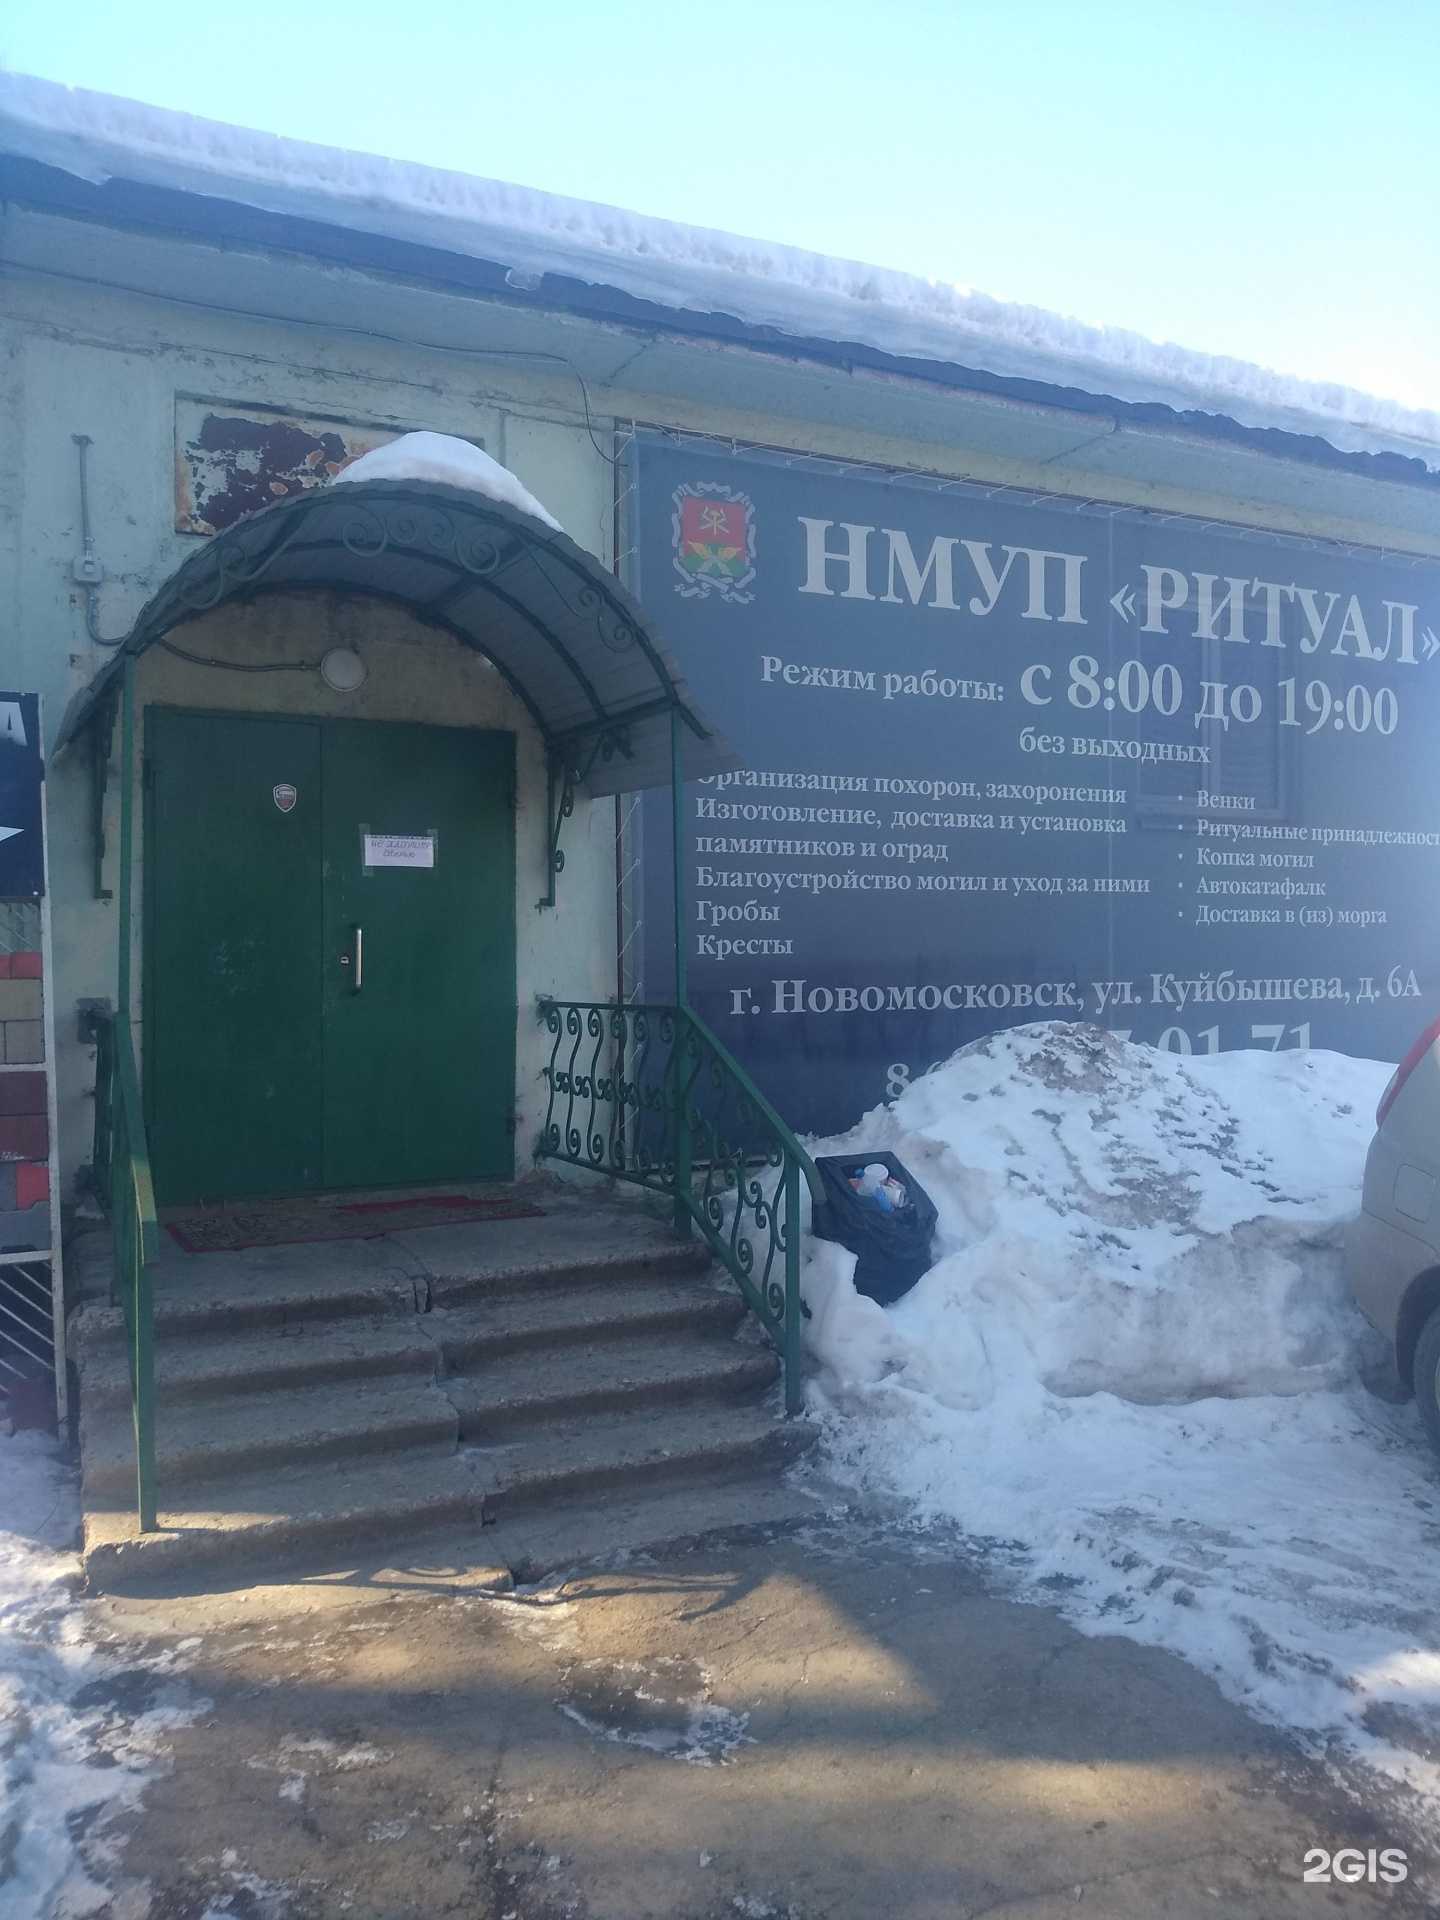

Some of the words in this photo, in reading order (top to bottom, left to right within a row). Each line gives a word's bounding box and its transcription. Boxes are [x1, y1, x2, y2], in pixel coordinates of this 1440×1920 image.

[798, 516, 1088, 625] НМУП
[760, 655, 877, 691] Режим
[883, 669, 1004, 702] работы:
[1067, 655, 1184, 716] 8:00
[1194, 681, 1263, 731] до
[1278, 677, 1399, 735] 19:00
[1019, 726, 1066, 754] без
[1071, 736, 1212, 765] выходных
[698, 770, 867, 793] рганизация
[874, 778, 982, 801] похорон,
[986, 783, 1127, 805] захоронения
[1196, 790, 1256, 810] Венки
[695, 797, 882, 829] Изготовление,
[890, 811, 995, 830] доставка
[1000, 814, 1015, 829] и
[1018, 815, 1128, 835] установка
[1196, 819, 1307, 842] Ритуальные
[695, 836, 855, 856] памятников
[860, 842, 877, 857] и
[882, 843, 949, 863] оград
[1196, 848, 1255, 866] Копка
[1260, 853, 1315, 868] могил
[695, 866, 912, 894] Благоустройство
[916, 876, 988, 891] могил
[993, 876, 1008, 891] и
[1011, 877, 1063, 897] уход
[1067, 878, 1088, 892] за
[1093, 879, 1151, 893] ними
[1195, 877, 1326, 899] Автокатафалк
[695, 900, 781, 926] Гробы
[1196, 905, 1280, 926] Доставка
[1285, 910, 1295, 923] в
[1299, 906, 1333, 927] (из)
[1337, 911, 1387, 927] морга
[695, 934, 793, 960] Кресты
[729, 987, 761, 1015] г.
[771, 975, 1084, 1014] Новомосковск,
[1092, 980, 1142, 1014] ул.
[1150, 969, 1351, 1012] Куйбышева,
[1356, 977, 1381, 1004] д.
[1387, 965, 1422, 998] 6А
